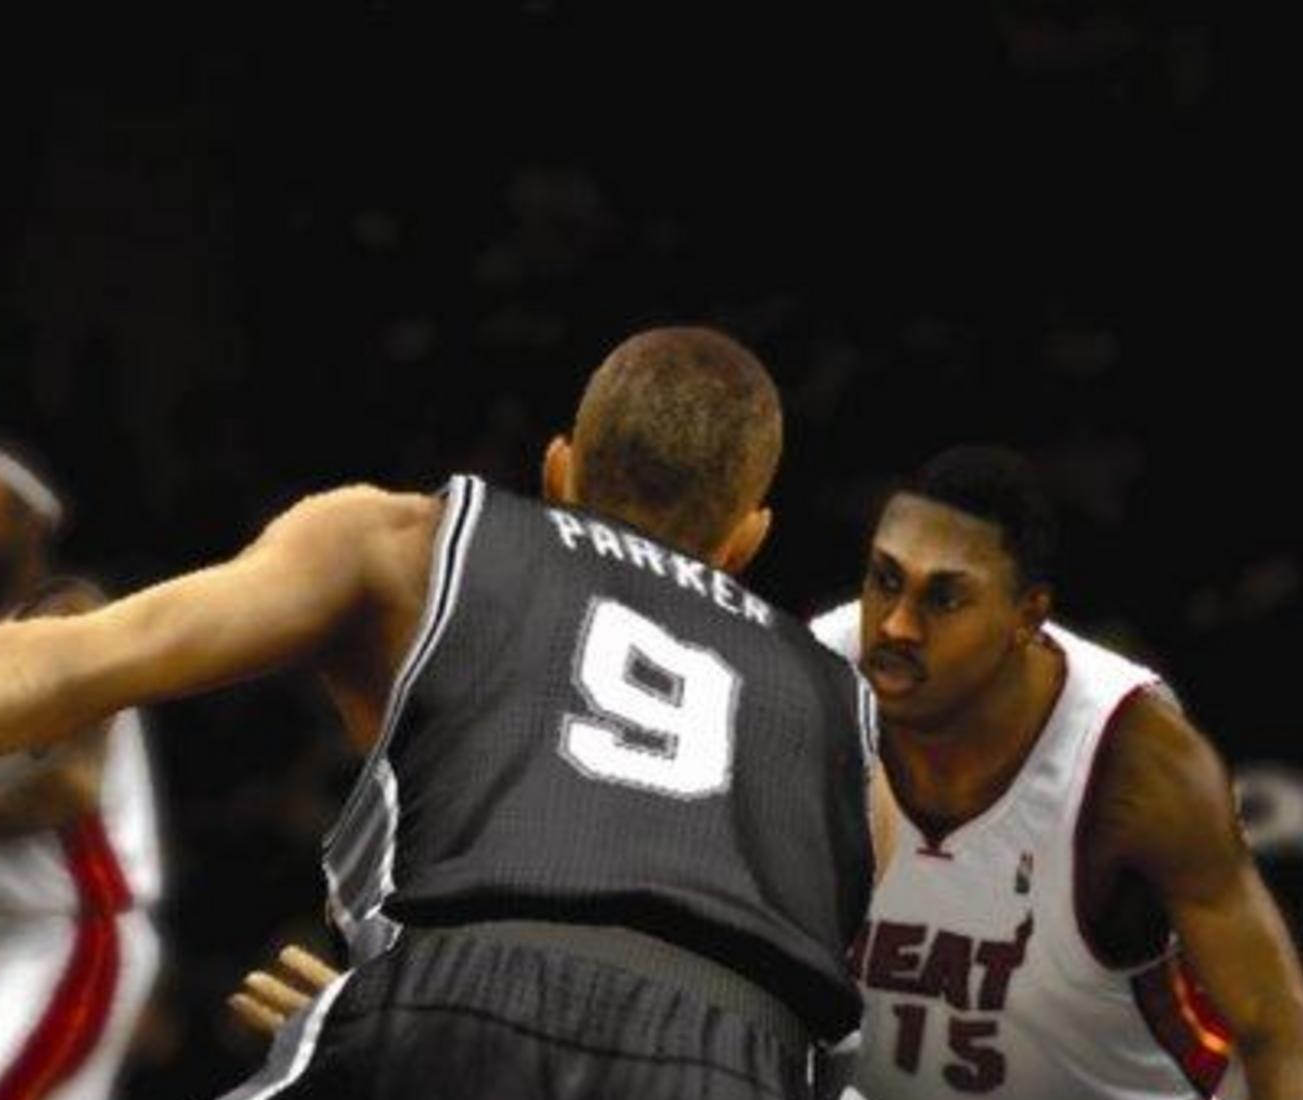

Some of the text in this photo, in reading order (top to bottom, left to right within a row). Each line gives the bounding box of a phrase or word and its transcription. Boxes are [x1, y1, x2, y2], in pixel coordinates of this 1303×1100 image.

[547, 507, 773, 629] PARKER
[558, 595, 743, 800] 9
[891, 1002, 1006, 1094] 15
